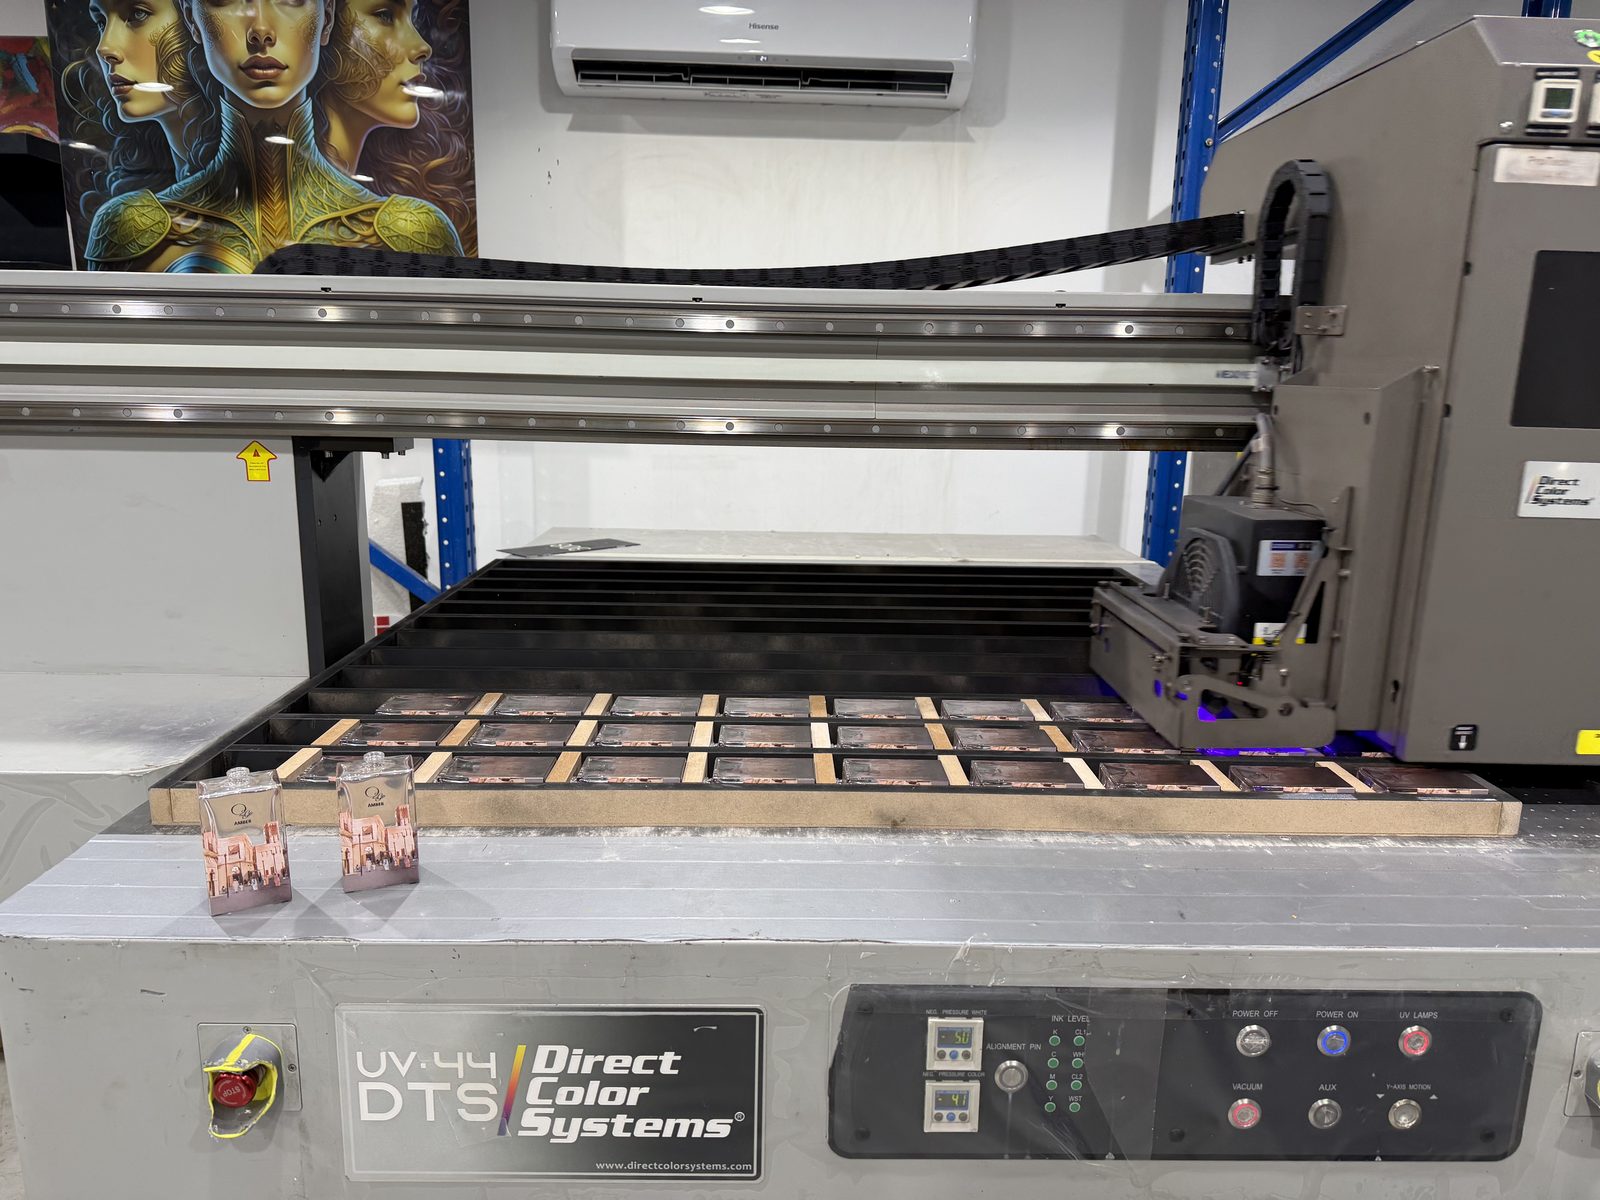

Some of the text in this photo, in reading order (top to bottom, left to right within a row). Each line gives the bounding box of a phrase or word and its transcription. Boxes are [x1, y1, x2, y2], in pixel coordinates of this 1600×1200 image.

[748, 22, 779, 31] Hisense
[1232, 1010, 1279, 1018] POWER OFF
[1316, 1010, 1359, 1019] POWER ON
[1399, 1011, 1439, 1019] UV LAMPS
[1067, 1015, 1090, 1023] LEVEL
[531, 1044, 682, 1075] Direct
[222, 1086, 241, 1097] STOP
[525, 1076, 650, 1106] Color
[1232, 1083, 1263, 1091] VACUUM
[1318, 1083, 1337, 1091] AUX
[358, 1081, 498, 1121] DTS
[595, 1161, 753, 1172] www.directcolorsystems.com
